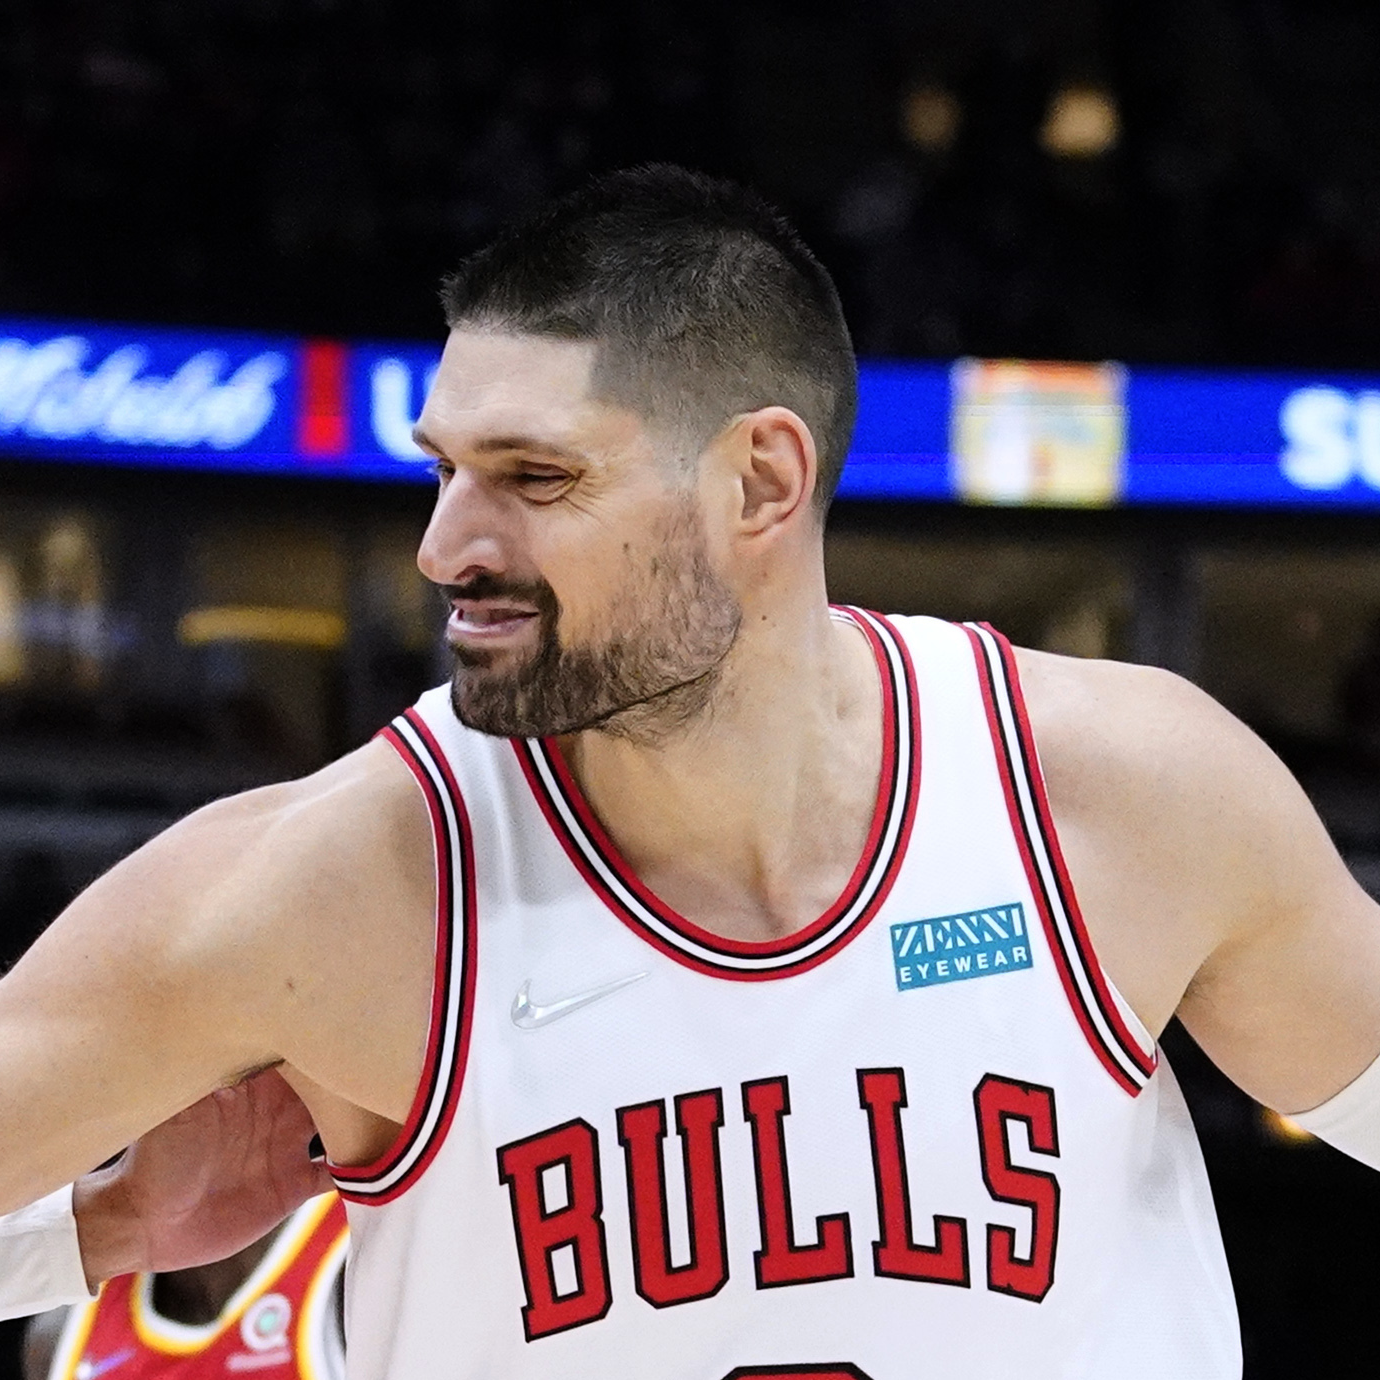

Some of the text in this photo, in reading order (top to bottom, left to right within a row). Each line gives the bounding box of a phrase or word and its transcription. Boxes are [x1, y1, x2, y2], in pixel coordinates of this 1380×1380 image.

[895, 908, 1023, 957] ZENNI
[900, 946, 1027, 983] EYEWEAR
[496, 1067, 1061, 1343] BULLS
